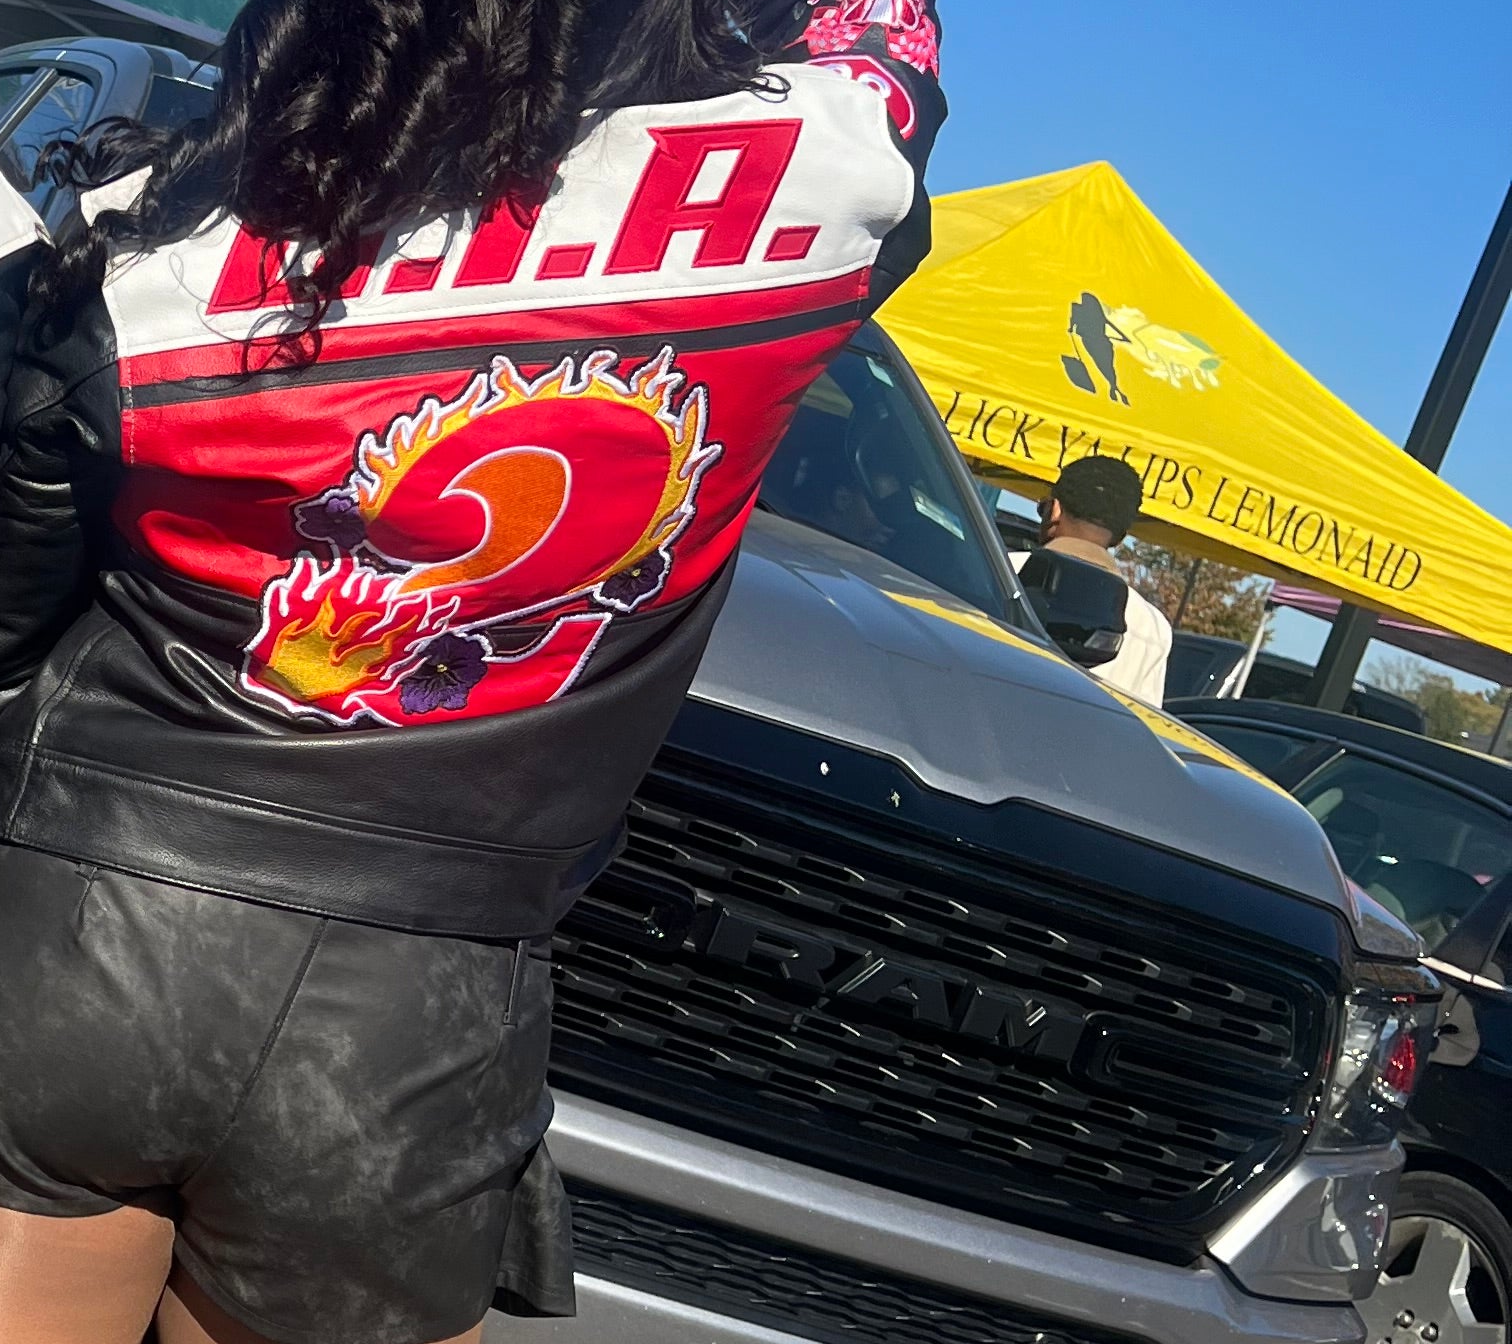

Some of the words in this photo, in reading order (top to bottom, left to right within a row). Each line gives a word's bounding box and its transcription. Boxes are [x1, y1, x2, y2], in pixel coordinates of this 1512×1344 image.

[944, 390, 1045, 460] LICK
[1206, 476, 1422, 591] LEMONAID
[705, 903, 1087, 1066] RAM
